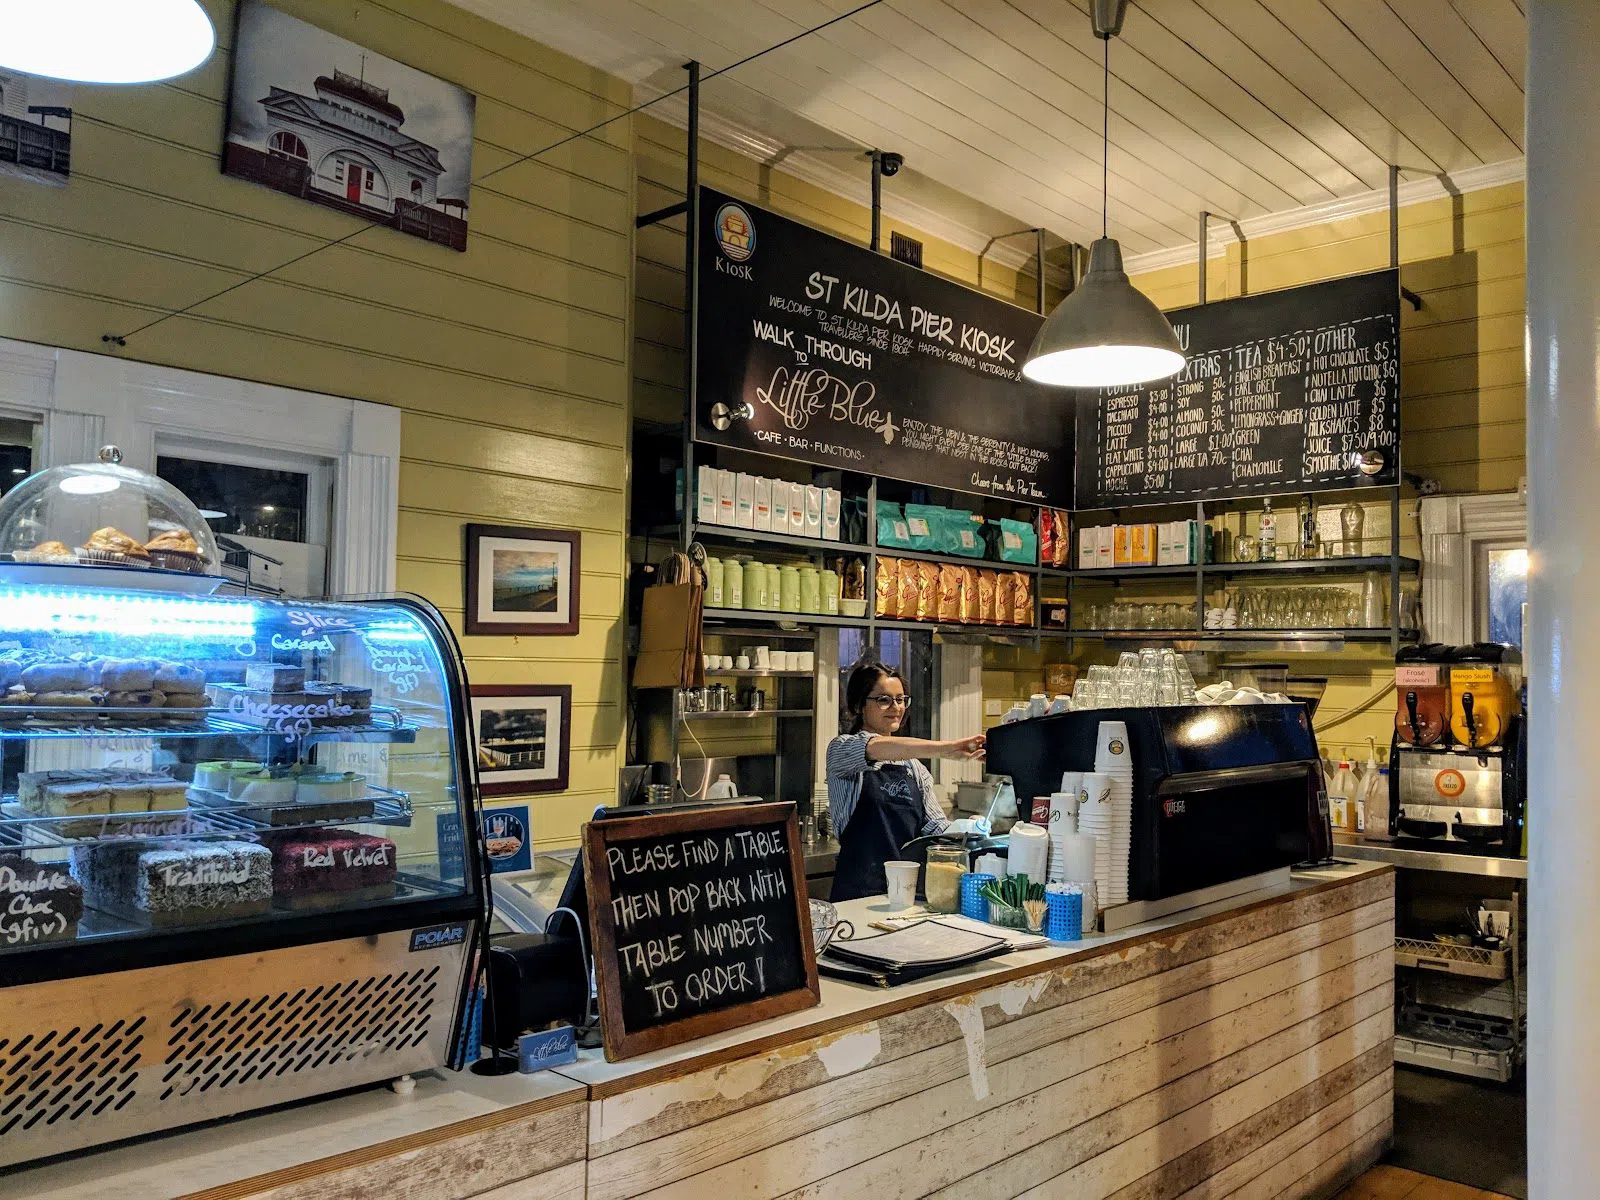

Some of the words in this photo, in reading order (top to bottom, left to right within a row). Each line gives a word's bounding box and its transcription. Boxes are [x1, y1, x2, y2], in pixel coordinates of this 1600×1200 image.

[716, 256, 753, 281] KIOSK
[805, 272, 839, 303] ST
[843, 283, 904, 330] KILDA
[910, 306, 954, 345] PIER
[960, 324, 1015, 364] KIOSK
[753, 319, 794, 349] WALK
[804, 335, 872, 371] THROUGH
[769, 294, 813, 317] WELCOME
[815, 309, 827, 321] TO
[830, 315, 844, 326] ST
[846, 319, 870, 336] KILDA
[892, 333, 915, 349] KIOSK
[1015, 371, 1021, 382] &
[867, 336, 888, 350] SINCE
[1315, 326, 1357, 355] OTHER
[794, 350, 808, 363] TO
[1235, 345, 1261, 370] TEA
[1313, 356, 1328, 370] HOT
[1330, 347, 1370, 367] CHOCOLATE
[1374, 341, 1389, 361] $5
[1235, 367, 1261, 384] ENGLISH
[1263, 360, 1302, 379] BREAKFAST
[1311, 368, 1348, 388] NUTELLA
[1382, 359, 1396, 378] $6
[1177, 381, 1204, 397] STRONG
[1235, 381, 1252, 397] EARL
[1256, 378, 1276, 394] GREY
[1310, 389, 1328, 403] CHAI
[1331, 384, 1357, 401] LATTE
[1374, 380, 1387, 397] $6
[756, 366, 828, 430] Little
[817, 375, 884, 429] Blue
[1107, 395, 1139, 411] ESPRESSO
[1177, 397, 1191, 409] SOY
[1235, 392, 1281, 412] PEPPERMINT
[1107, 407, 1139, 424] MACCHIATO
[1176, 408, 1204, 423] ALMOND
[1309, 406, 1336, 422] GOLDEN
[1339, 400, 1361, 417] LATTE
[1371, 397, 1386, 415] $5
[902, 418, 928, 432] ENJOY
[930, 425, 943, 436] THE
[968, 434, 979, 444] THE
[905, 429, 918, 439] YOU
[1107, 423, 1132, 438] PICCOLO
[1176, 420, 1209, 437] COCONUT
[1308, 416, 1360, 437] MILKSHAKES
[1369, 414, 1384, 432] $8
[757, 431, 781, 444] CAFE
[789, 436, 809, 449] BAR
[814, 441, 862, 461] FUNCTIONS
[1106, 436, 1128, 451] LATTE
[1176, 438, 1198, 454] LARGE
[1235, 429, 1260, 445] GREEN
[1307, 437, 1332, 454] JUICE
[1105, 451, 1121, 466] FLAT
[1123, 447, 1145, 462] WHITE
[1174, 454, 1196, 469] LARGE
[1235, 447, 1253, 462] CHAI
[1305, 453, 1342, 475] SMOOTHIE
[1105, 461, 1144, 479] CAPPUCCINO
[1235, 459, 1283, 478] CHAMOMILE
[1105, 476, 1129, 491] MOCHA
[286, 610, 354, 628] Slice
[272, 634, 335, 651] Caramel
[228, 694, 354, 719] Cheesecake
[303, 848, 335, 868] Red
[343, 844, 392, 868] Velvet
[605, 844, 682, 881] PLEASE
[682, 838, 720, 867] FIND
[725, 837, 735, 867] A
[0, 866, 68, 893] Double
[8, 894, 53, 915] Choc
[611, 890, 661, 931] THEN
[668, 883, 701, 916] POP
[705, 877, 747, 911] BACK
[749, 868, 787, 902] WITH
[415, 926, 463, 945] POLAR
[618, 934, 686, 978] TABLE
[694, 914, 773, 957] NUMBER
[645, 979, 678, 1017] TO
